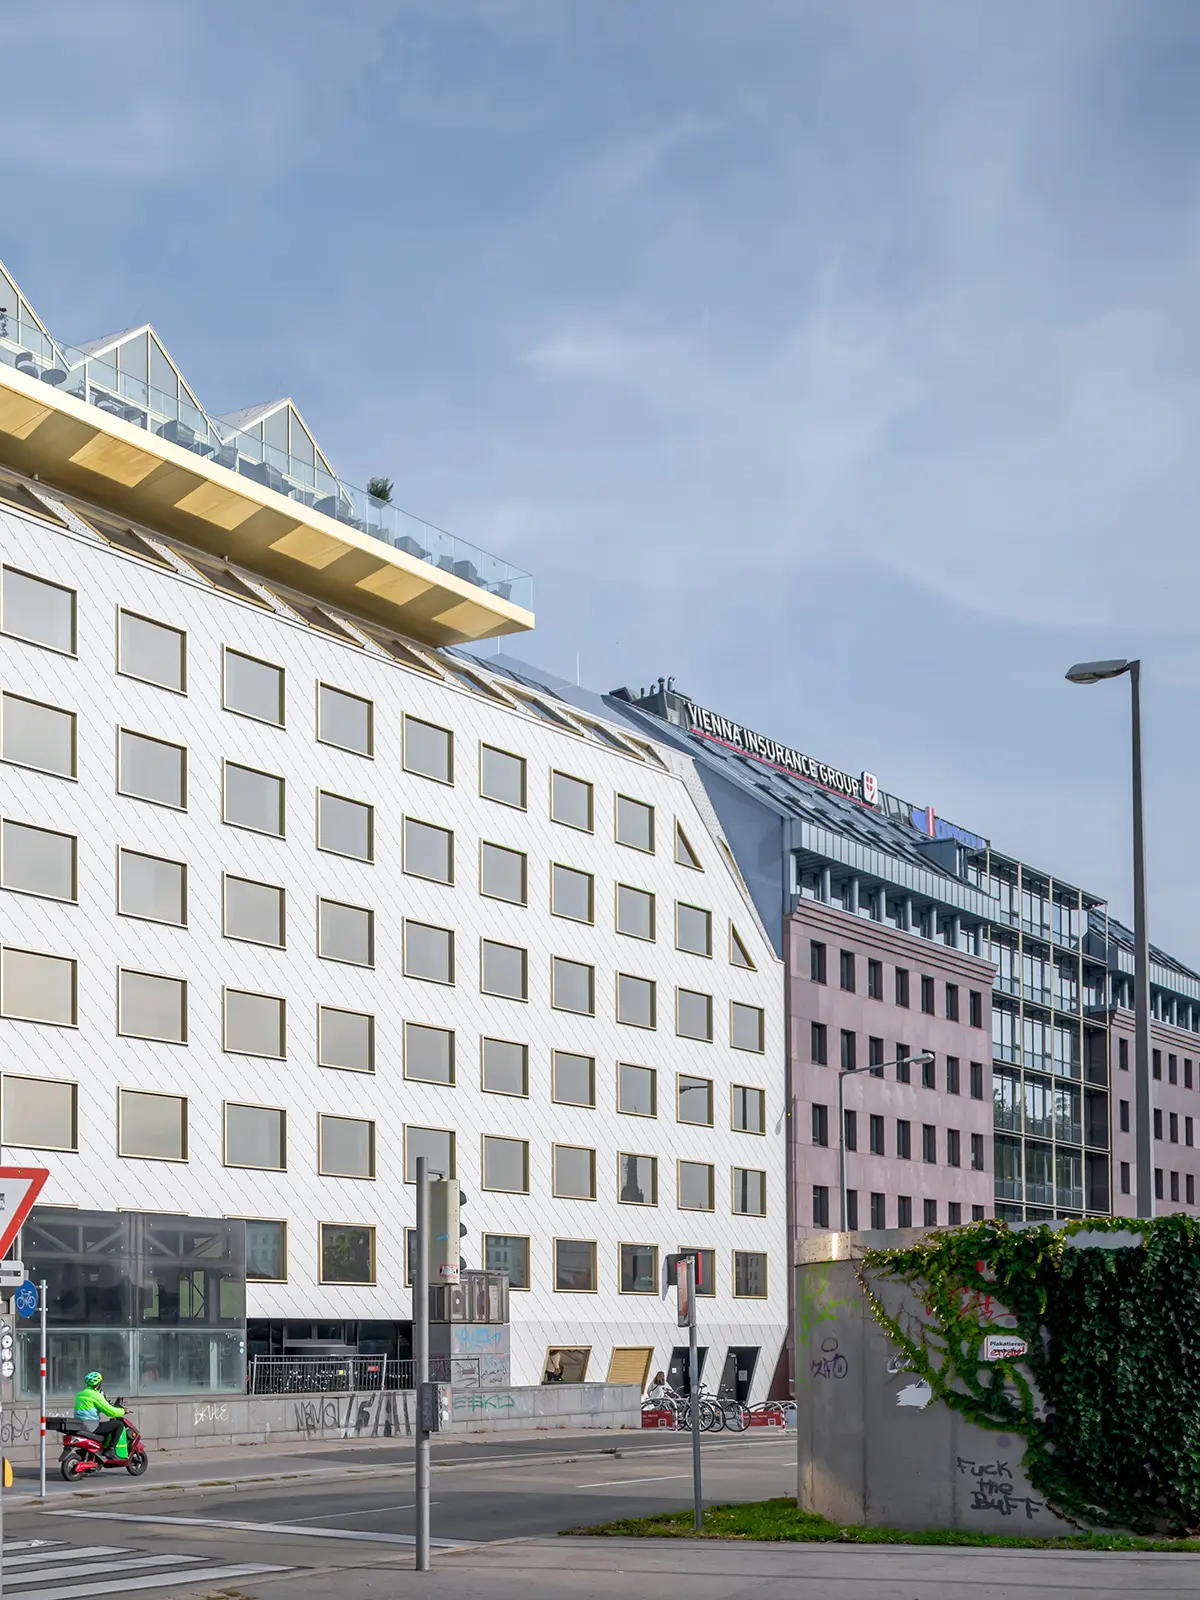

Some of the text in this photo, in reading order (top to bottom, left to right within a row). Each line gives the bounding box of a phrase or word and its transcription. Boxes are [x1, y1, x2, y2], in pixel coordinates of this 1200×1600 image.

[686, 702, 859, 796] VIENNA INSURANCE GROUP
